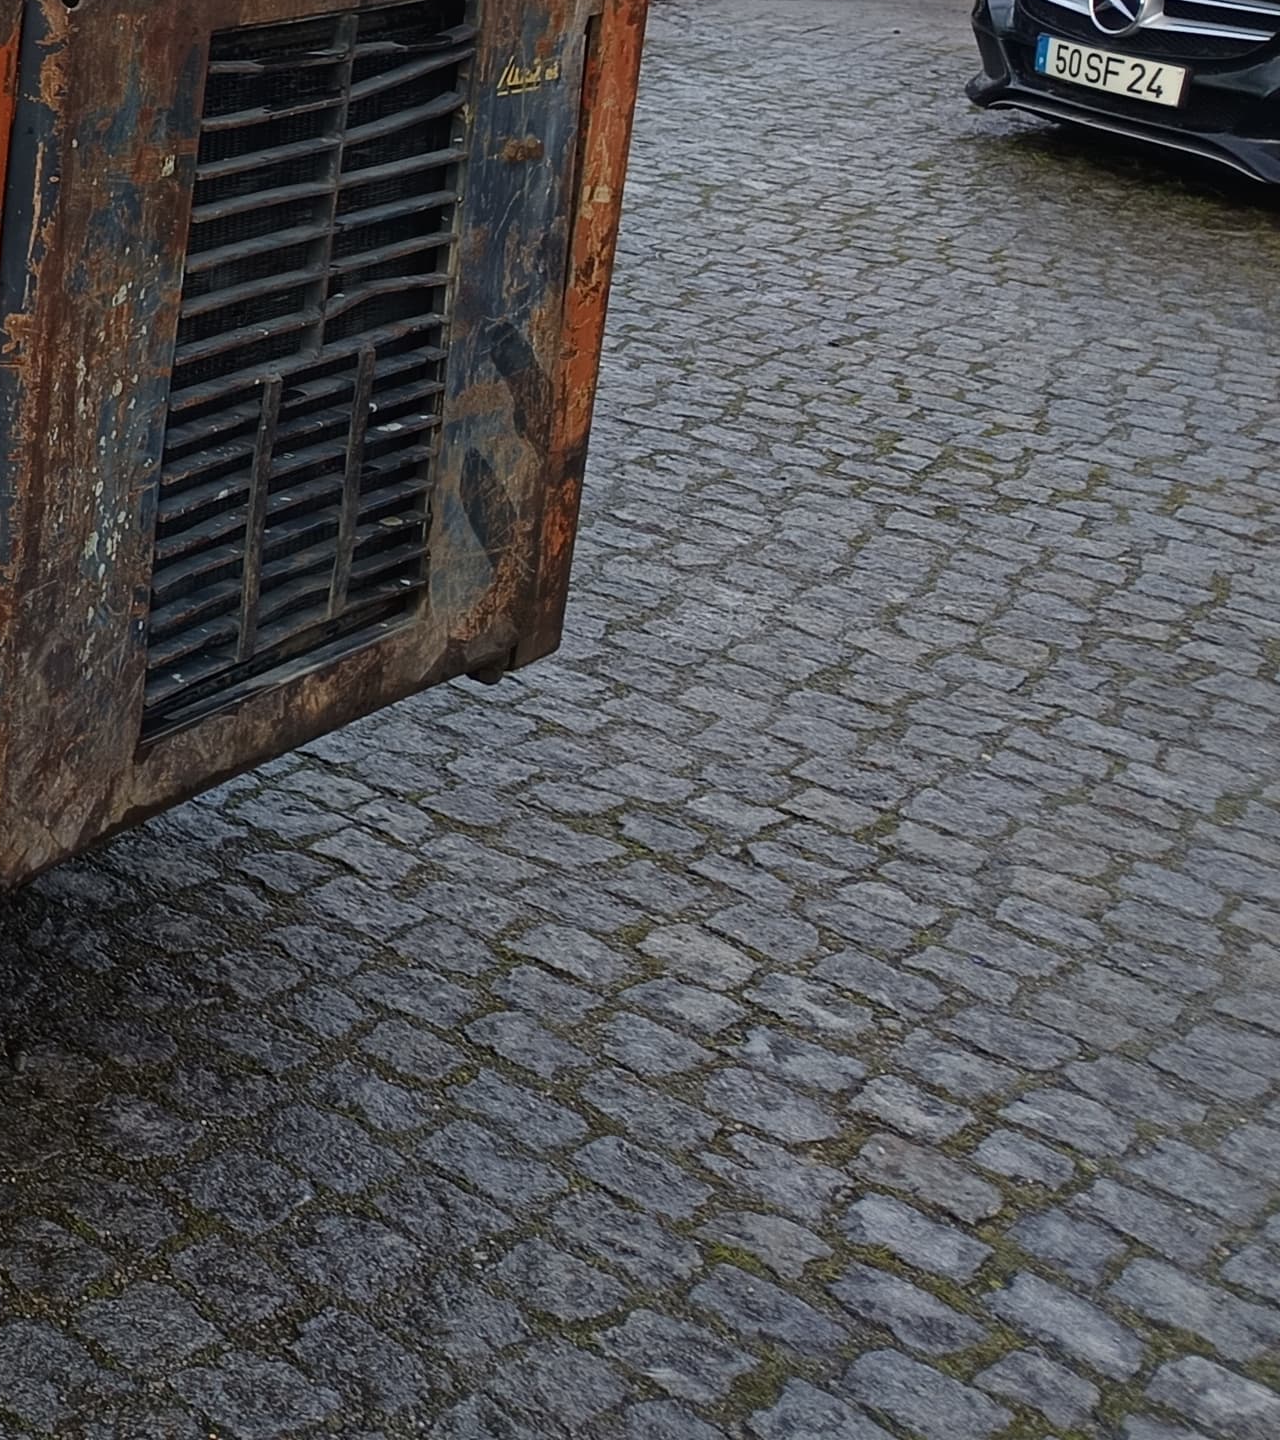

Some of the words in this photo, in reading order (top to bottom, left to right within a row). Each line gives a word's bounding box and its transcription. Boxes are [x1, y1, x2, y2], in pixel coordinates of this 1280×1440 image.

[1056, 44, 1083, 78] 50
[1085, 52, 1126, 87] SF
[1126, 63, 1164, 99] 24
